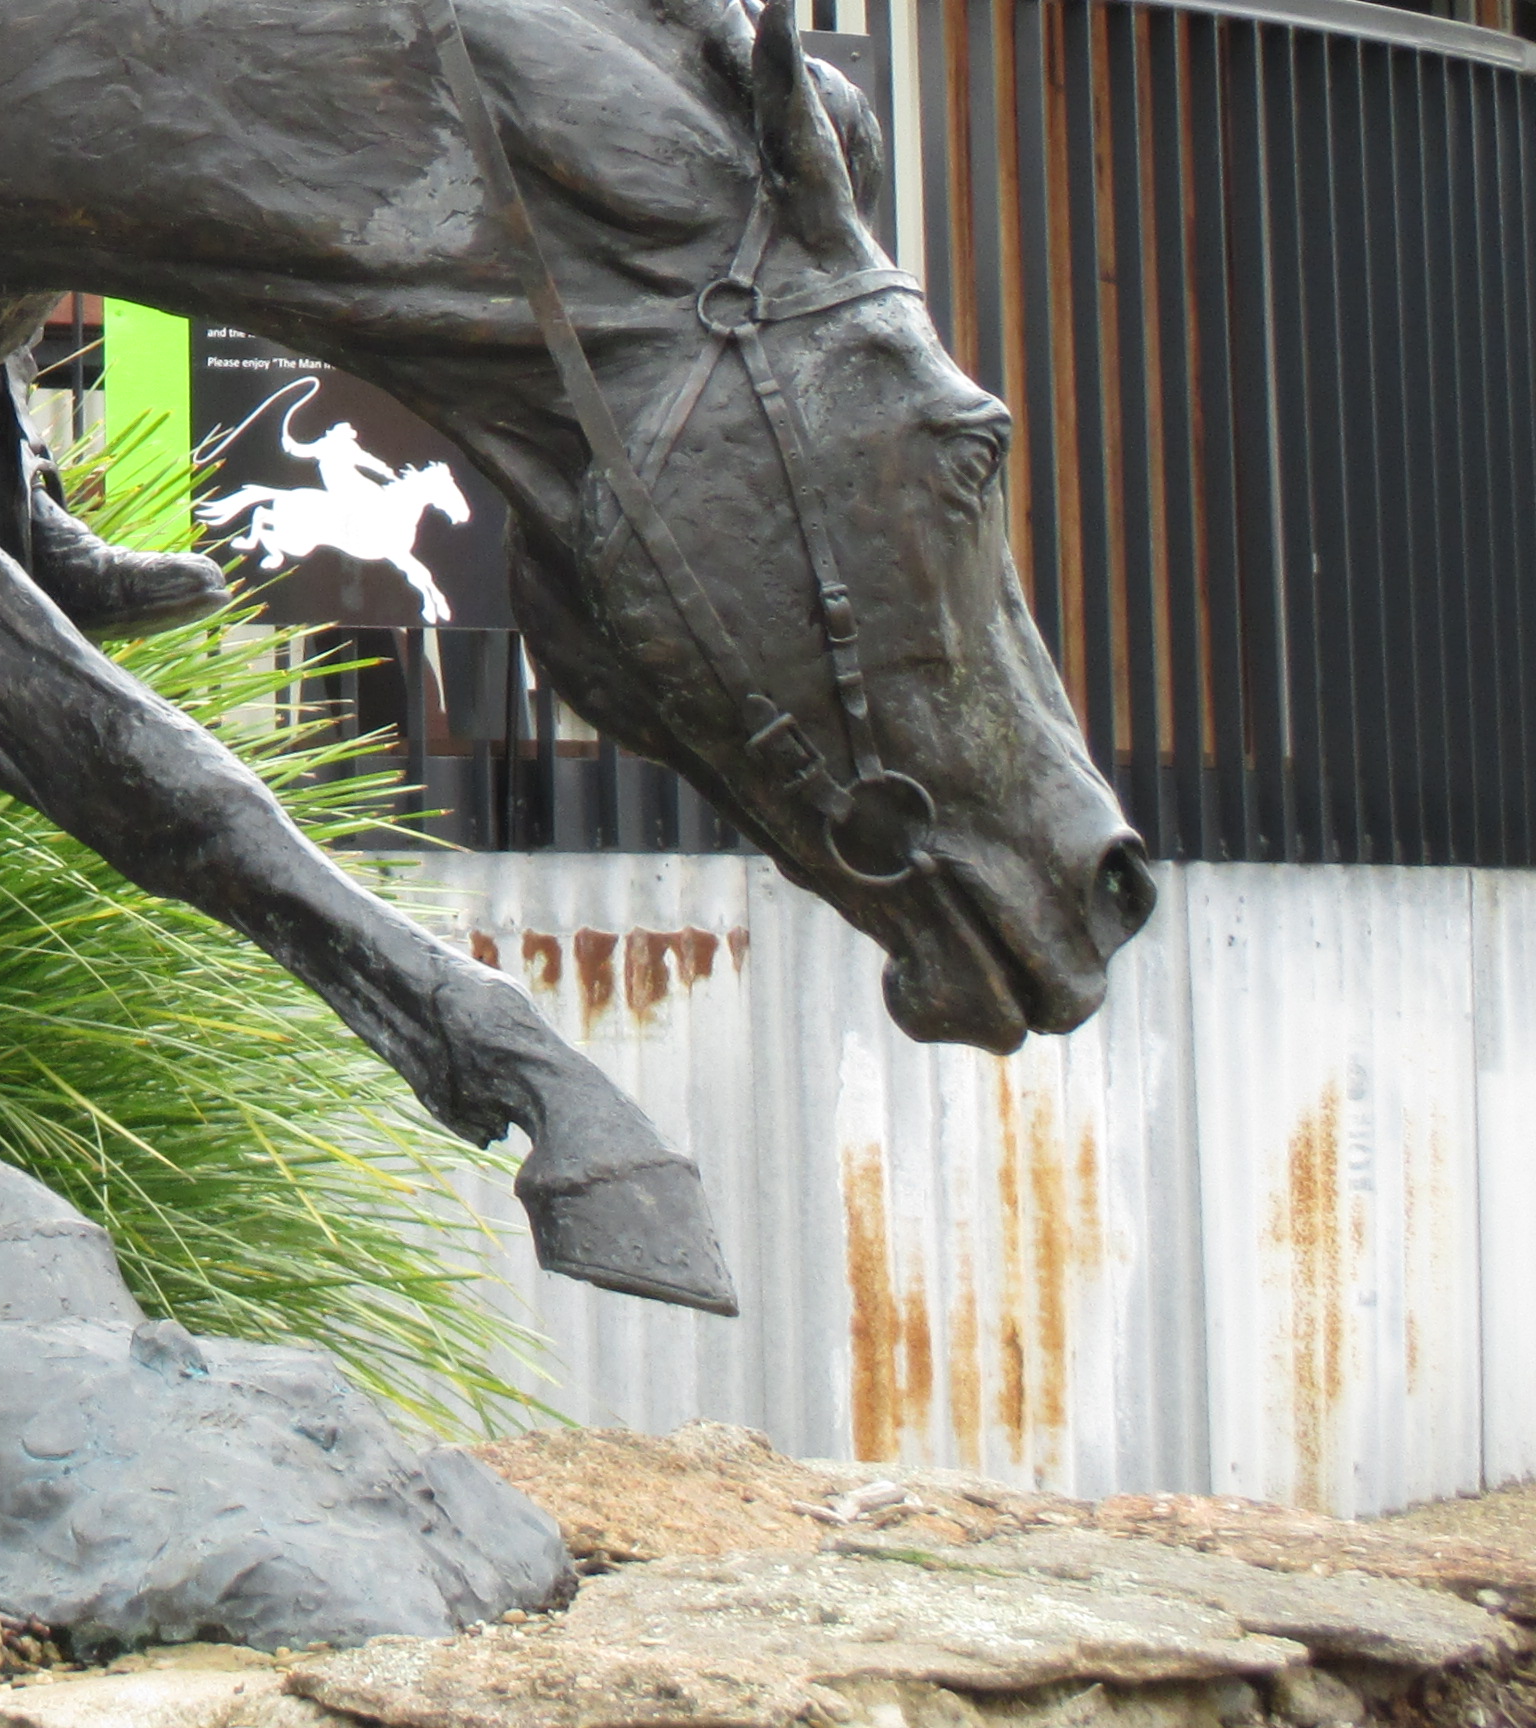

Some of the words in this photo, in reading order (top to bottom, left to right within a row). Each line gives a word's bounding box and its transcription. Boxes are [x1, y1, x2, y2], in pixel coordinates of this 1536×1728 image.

[207, 327, 227, 338] and
[207, 356, 240, 367] Please
[242, 358, 270, 370] enjoy
[298, 358, 322, 369] Man
